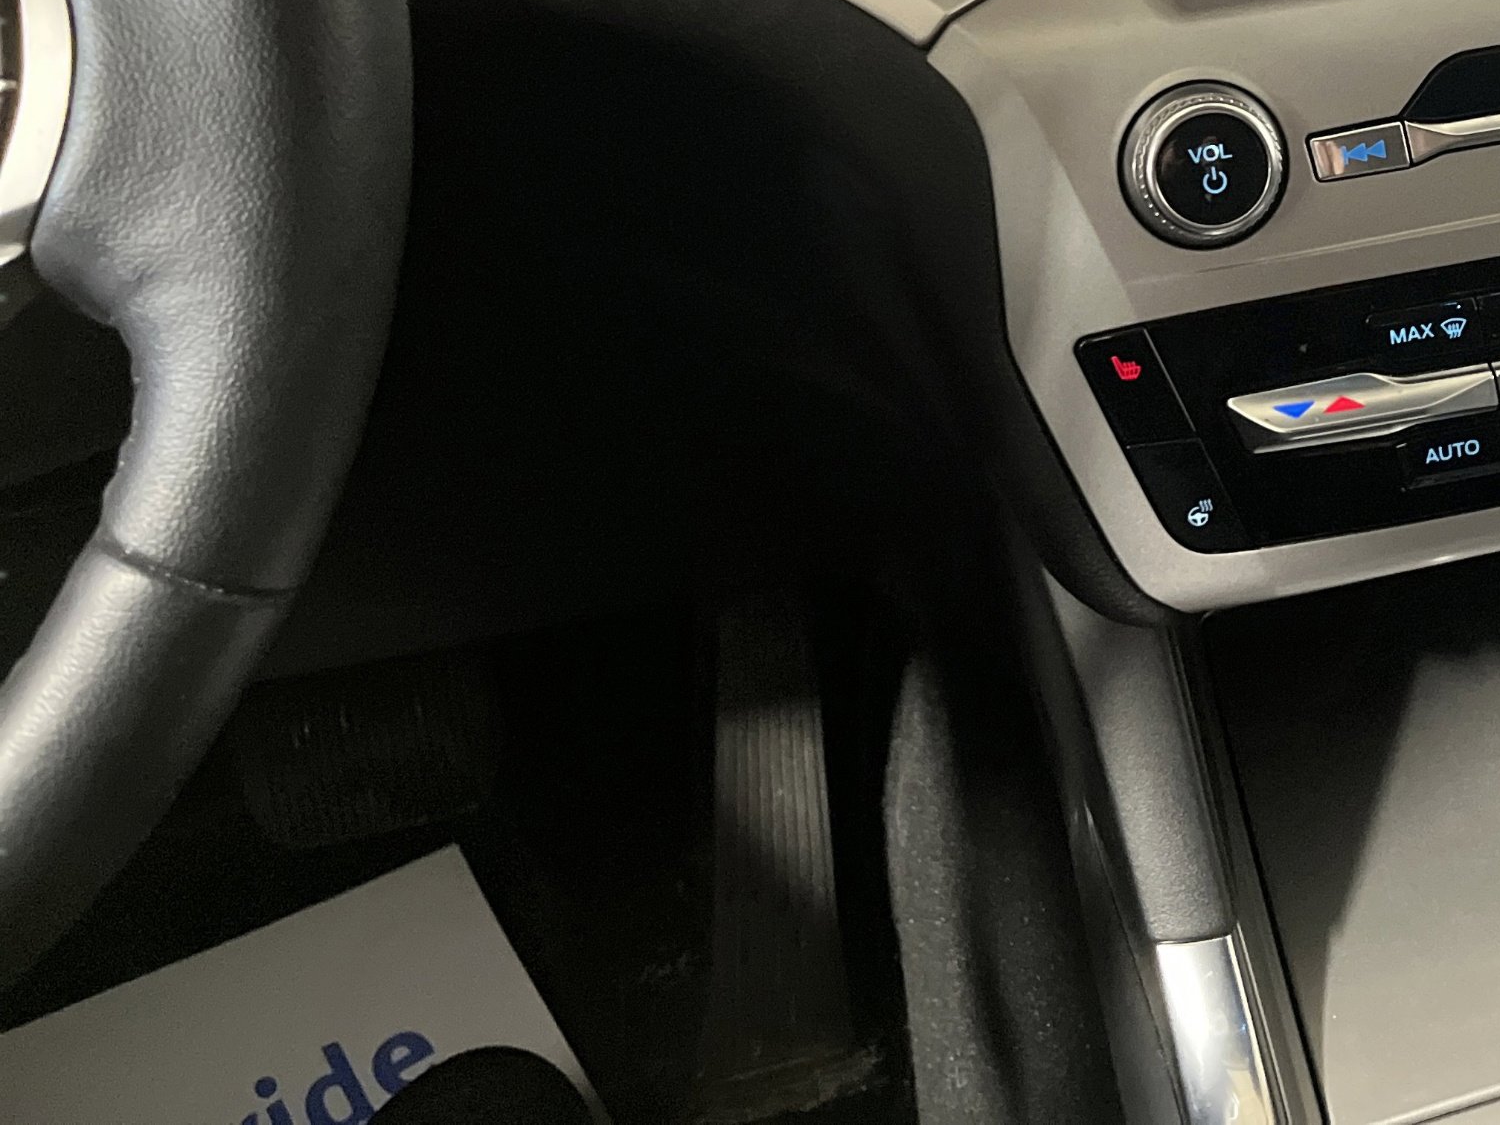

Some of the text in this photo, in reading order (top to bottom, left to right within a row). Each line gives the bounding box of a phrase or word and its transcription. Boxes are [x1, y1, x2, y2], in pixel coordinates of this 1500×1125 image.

[1187, 143, 1233, 164] VOL
[1389, 322, 1435, 345] MAX
[1425, 439, 1480, 464] AUTO
[240, 1030, 436, 1125] ide
